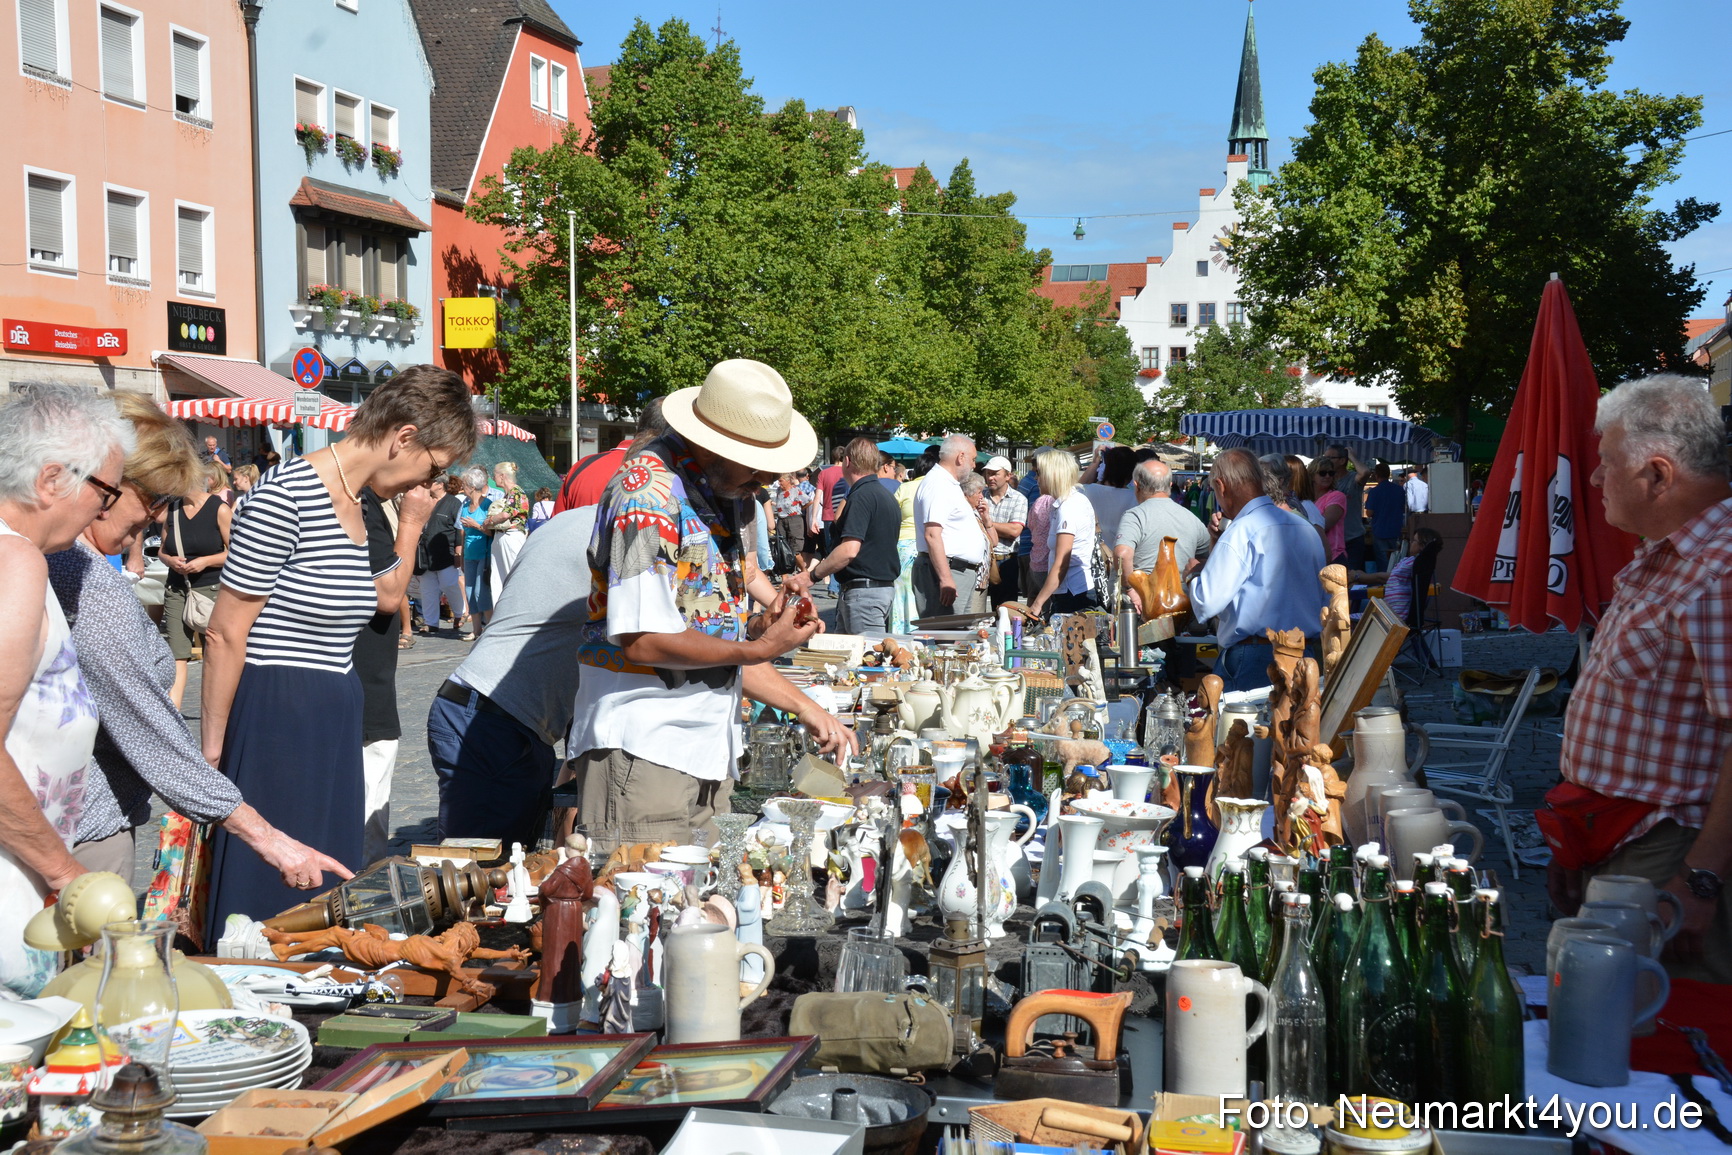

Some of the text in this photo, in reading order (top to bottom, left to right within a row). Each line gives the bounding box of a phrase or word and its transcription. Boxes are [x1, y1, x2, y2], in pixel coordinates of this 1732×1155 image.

[10, 329, 30, 345] DER
[54, 329, 78, 339] Deutsches
[54, 340, 77, 349] Reisebüro
[97, 335, 120, 348] DER
